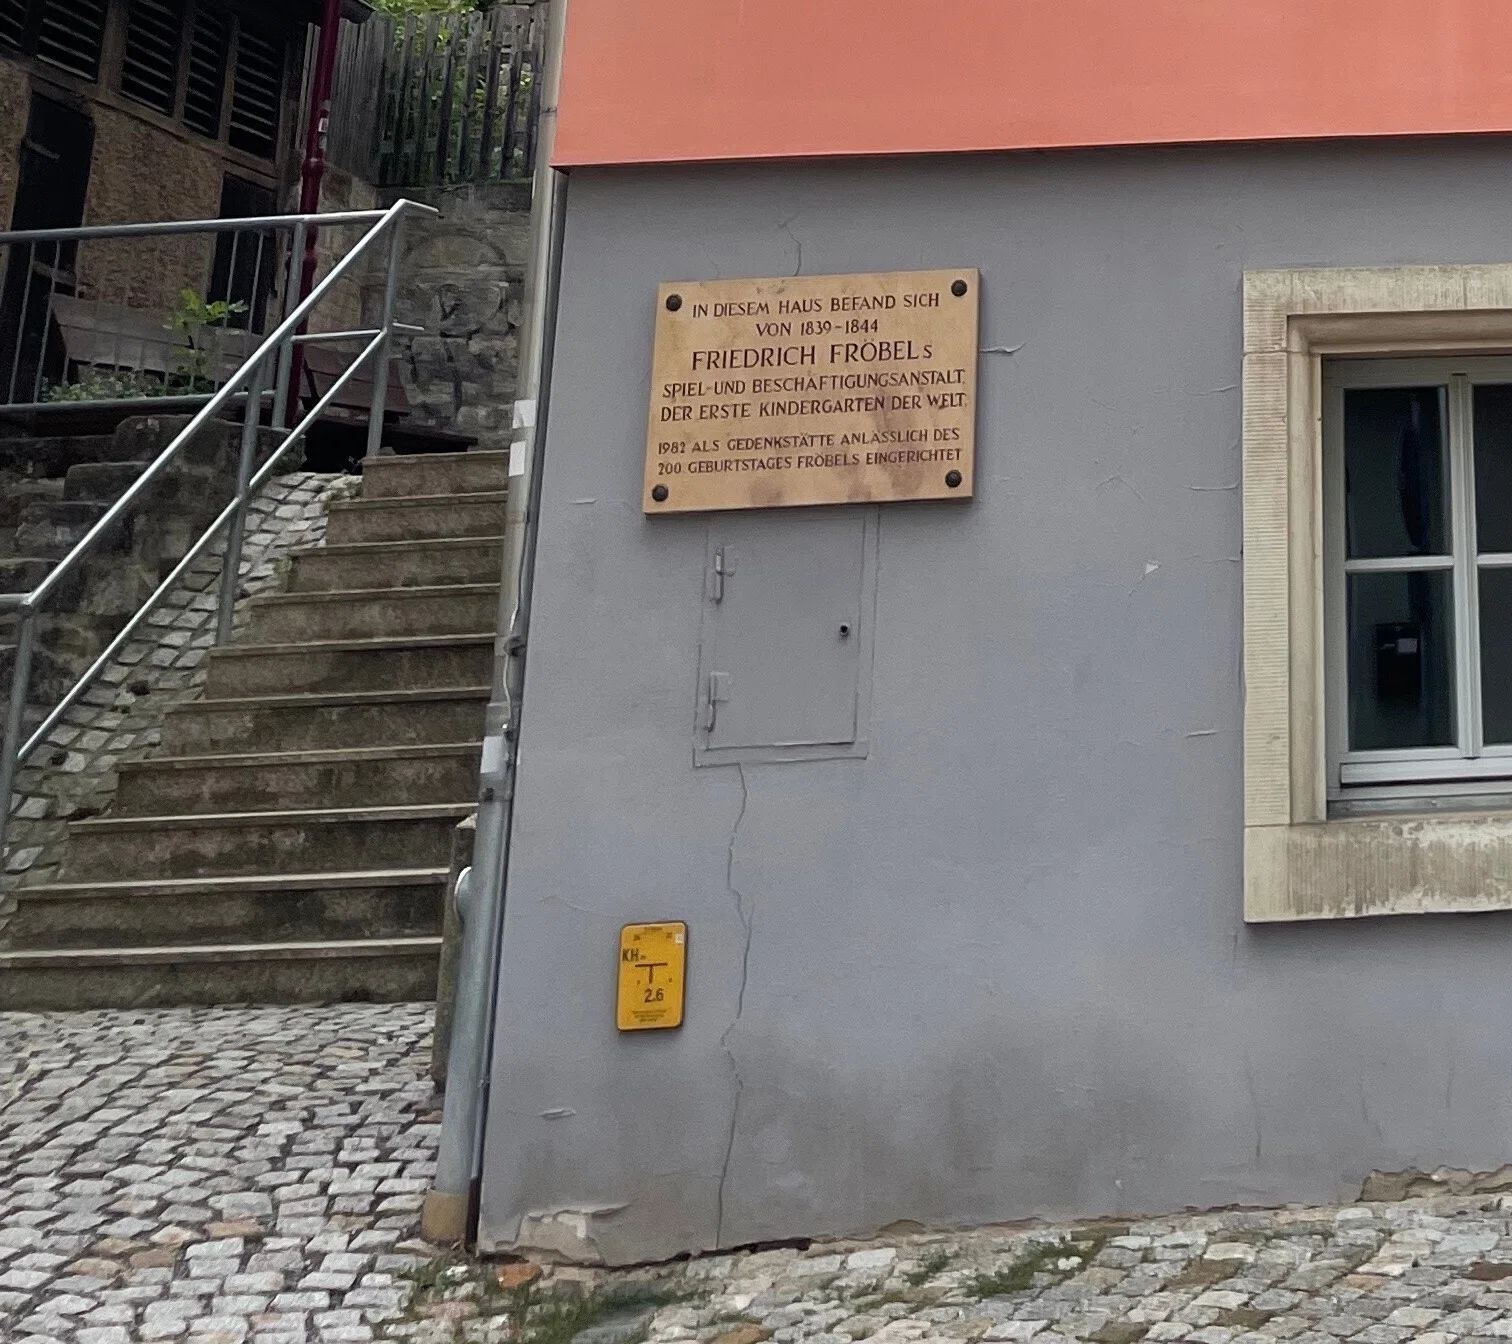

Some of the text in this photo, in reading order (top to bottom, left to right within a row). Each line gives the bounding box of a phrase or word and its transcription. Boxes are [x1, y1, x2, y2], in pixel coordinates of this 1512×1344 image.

[692, 293, 939, 318] IN DIESEM HAUS BEFAND SICH
[756, 321, 792, 336] VON
[692, 345, 815, 370] FRIEDRICH
[661, 404, 692, 422] DER
[700, 403, 751, 419] ERSTE
[759, 396, 885, 417] KINDERGARTEN
[891, 394, 922, 410] DER
[658, 427, 960, 454] 1982 ALS GEDENKSTÄTTE ANLÄSSLICH DES
[688, 456, 792, 474] GEBURTSTAGES
[797, 450, 860, 468] FRÖBELS
[866, 448, 962, 466] EINGERICHTET
